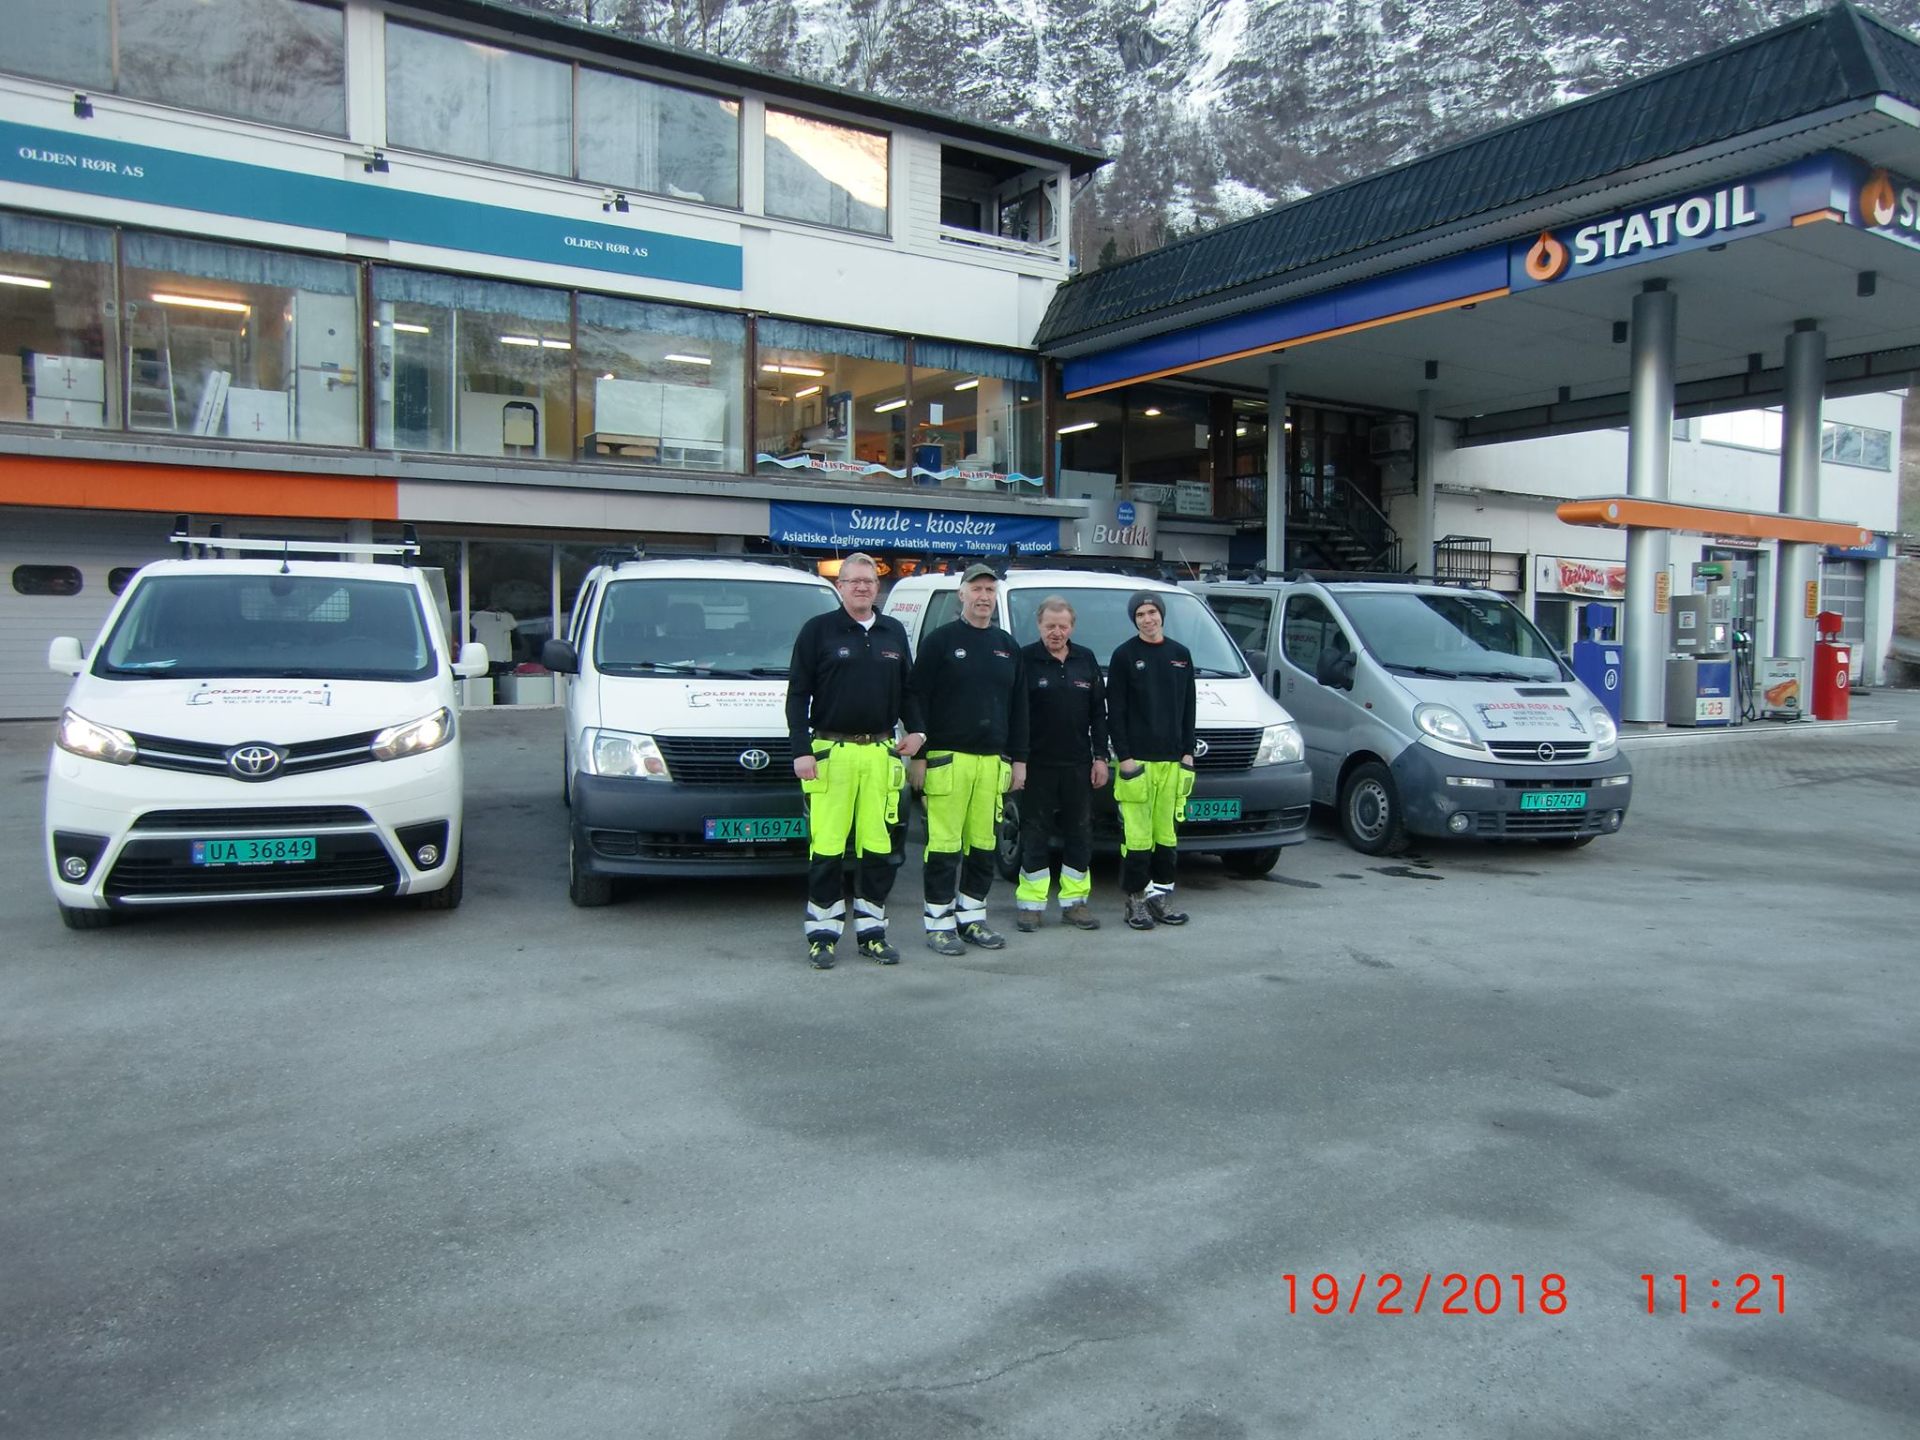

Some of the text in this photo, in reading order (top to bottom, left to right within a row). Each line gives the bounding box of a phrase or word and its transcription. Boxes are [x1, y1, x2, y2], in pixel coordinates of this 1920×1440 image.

[19, 147, 145, 178] OLDEN RØR AS
[1574, 185, 1756, 265] STATOIL
[564, 236, 648, 257] OLDEN RØR AS
[849, 508, 911, 532] Sunde
[926, 512, 996, 535] kiosken
[782, 531, 828, 543] Asiatiske
[830, 533, 885, 547] dagligvarer
[893, 537, 930, 549] Asiatisk
[932, 540, 957, 551] meny
[965, 540, 1008, 552] Takeaway
[1092, 524, 1150, 546] Butikk
[1194, 802, 1238, 817] 28944
[1545, 794, 1582, 807] 67474
[721, 820, 803, 836] XK 16974
[210, 840, 312, 860] UA 36849
